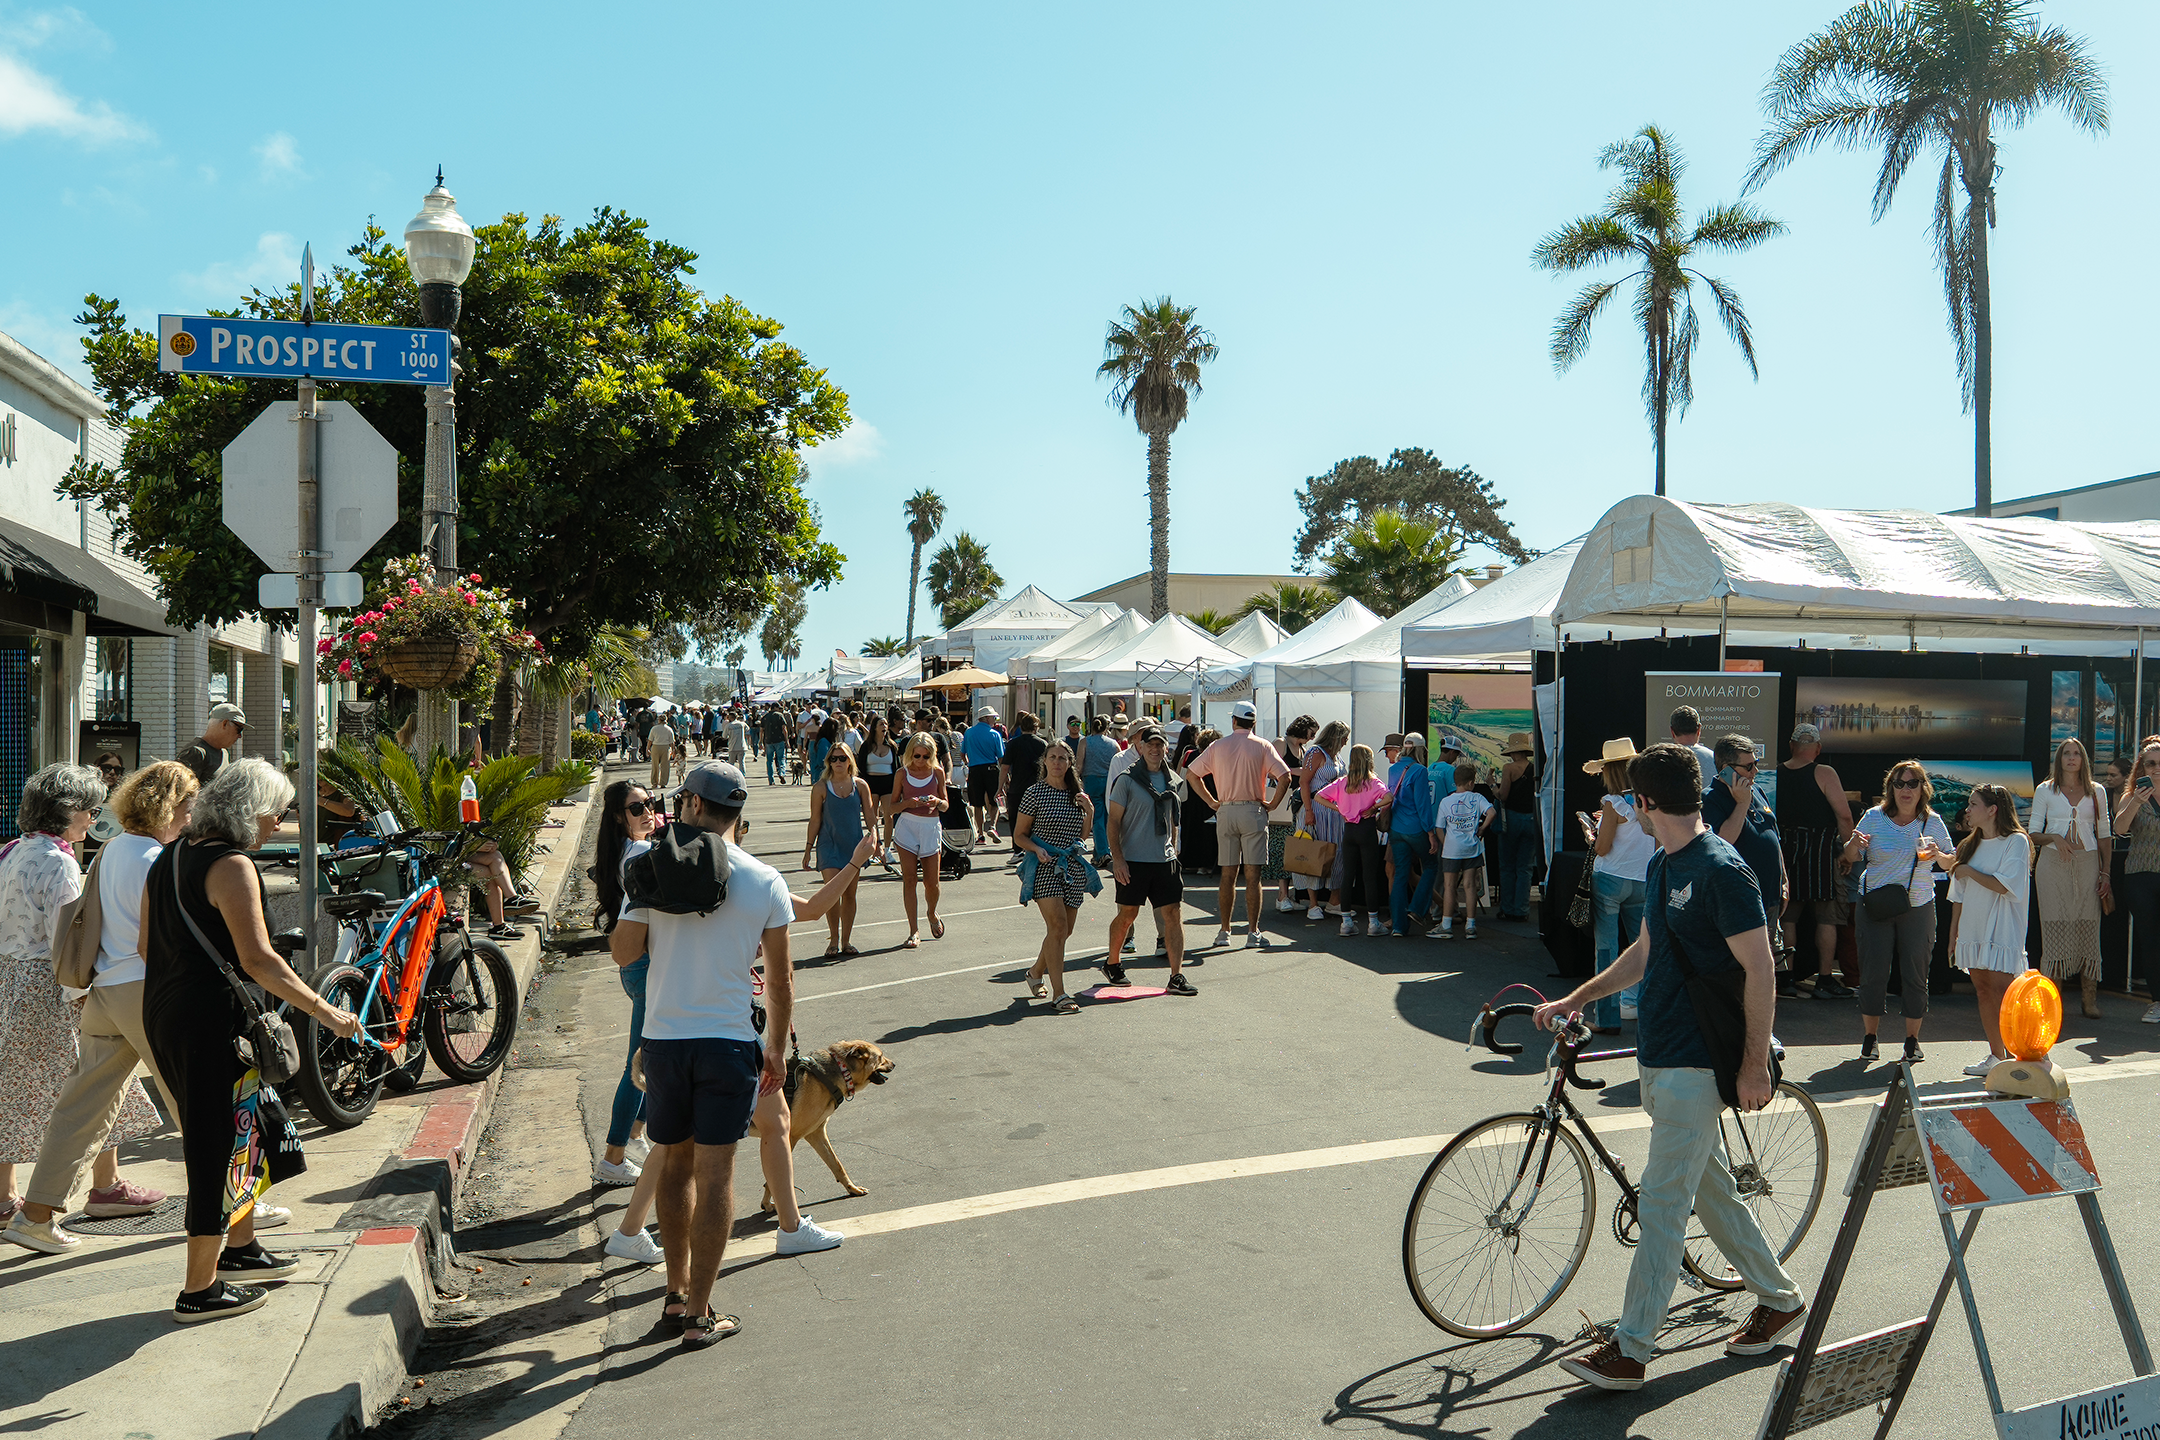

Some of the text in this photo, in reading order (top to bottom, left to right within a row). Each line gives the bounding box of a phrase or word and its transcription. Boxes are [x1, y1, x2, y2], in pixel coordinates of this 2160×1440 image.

[211, 327, 377, 370] PROSPECT
[410, 333, 428, 349] ST
[400, 351, 439, 368] 1000
[1665, 684, 1761, 698] BOMMARITO
[2060, 1392, 2129, 1440] ACME
